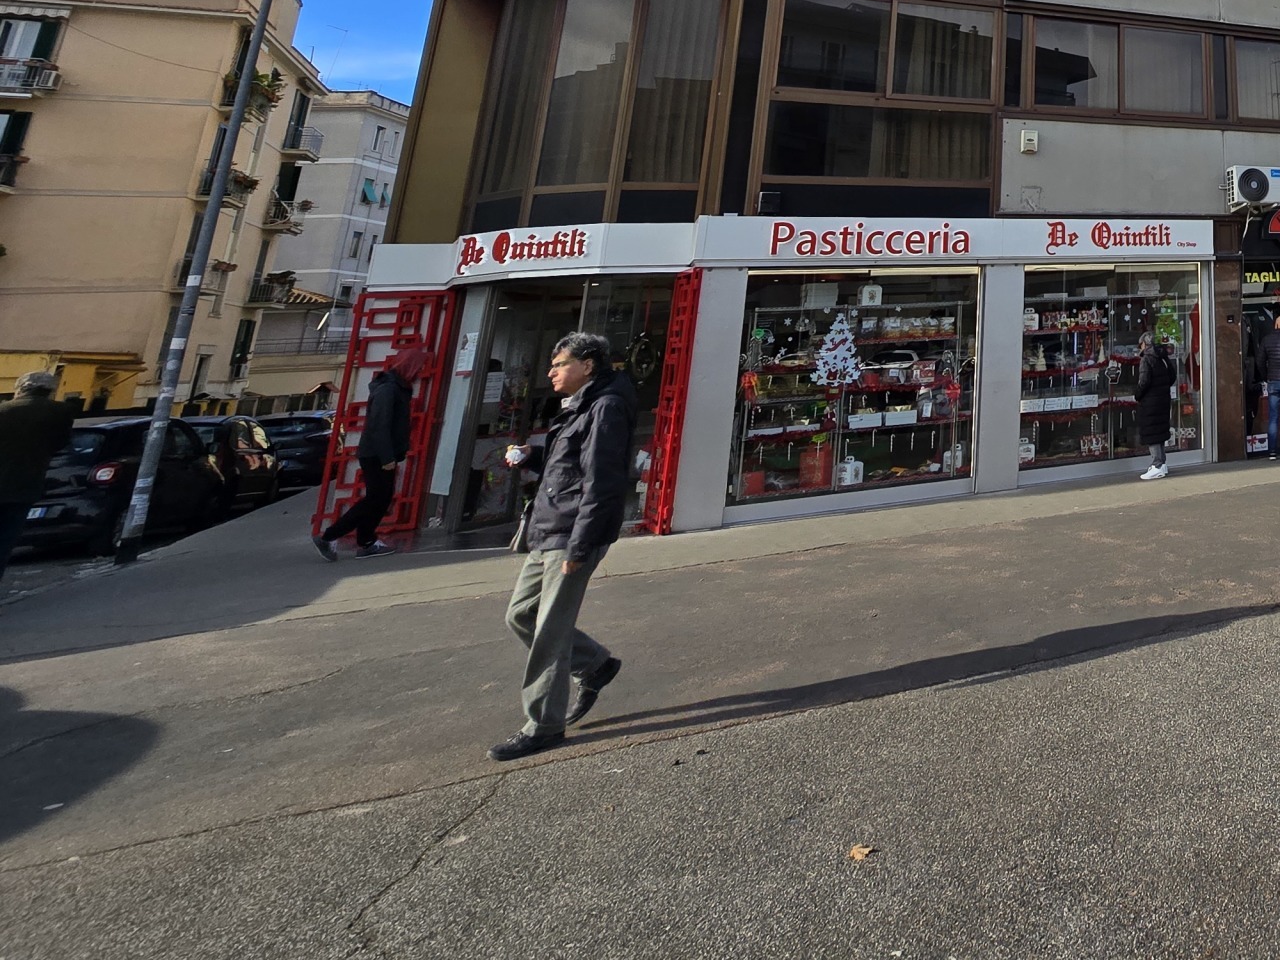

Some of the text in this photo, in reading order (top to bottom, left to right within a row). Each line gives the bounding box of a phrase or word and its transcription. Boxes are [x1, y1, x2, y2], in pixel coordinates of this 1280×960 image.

[771, 222, 970, 255] Pasticceria
[1046, 221, 1171, 255] De Quintili
